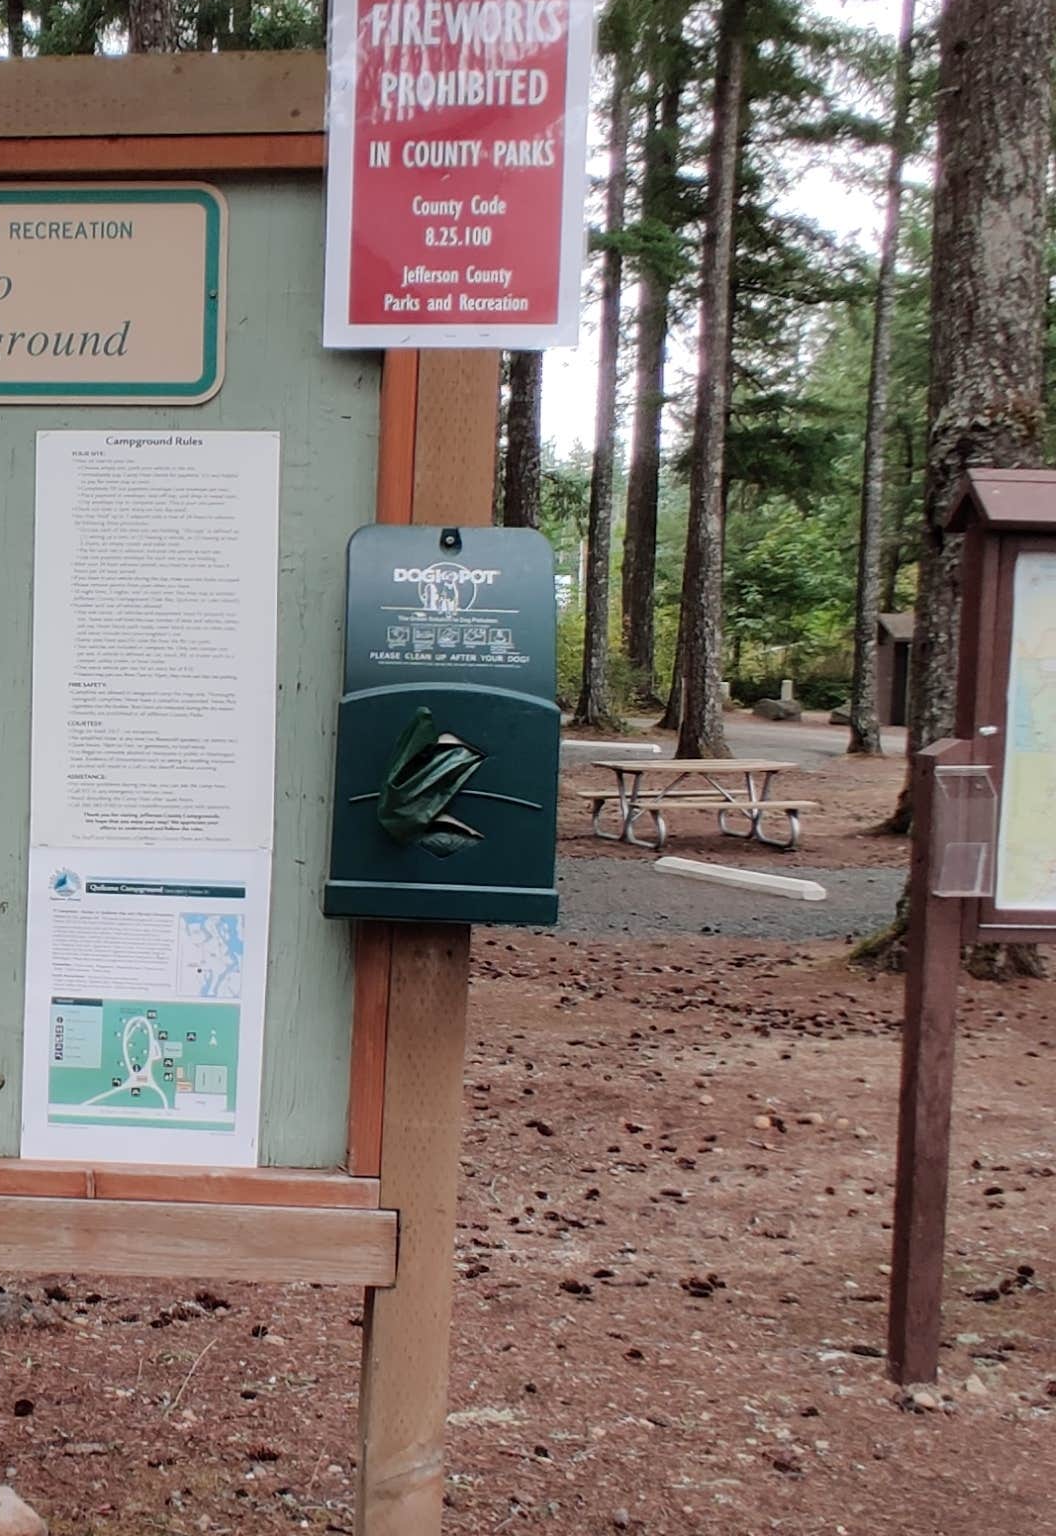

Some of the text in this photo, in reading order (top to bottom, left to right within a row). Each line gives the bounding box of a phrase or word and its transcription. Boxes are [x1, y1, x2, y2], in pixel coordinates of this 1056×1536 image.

[380, 69, 548, 108] PROHIBITED
[369, 138, 555, 168] IN COUNTY PARKS
[412, 195, 506, 219] County Code
[9, 221, 134, 240] RECREATION
[425, 226, 492, 247] 8.25.100
[401, 265, 513, 288] Jefferson County
[384, 293, 529, 312] Parks and Recreation
[105, 435, 204, 448] Campground Rules
